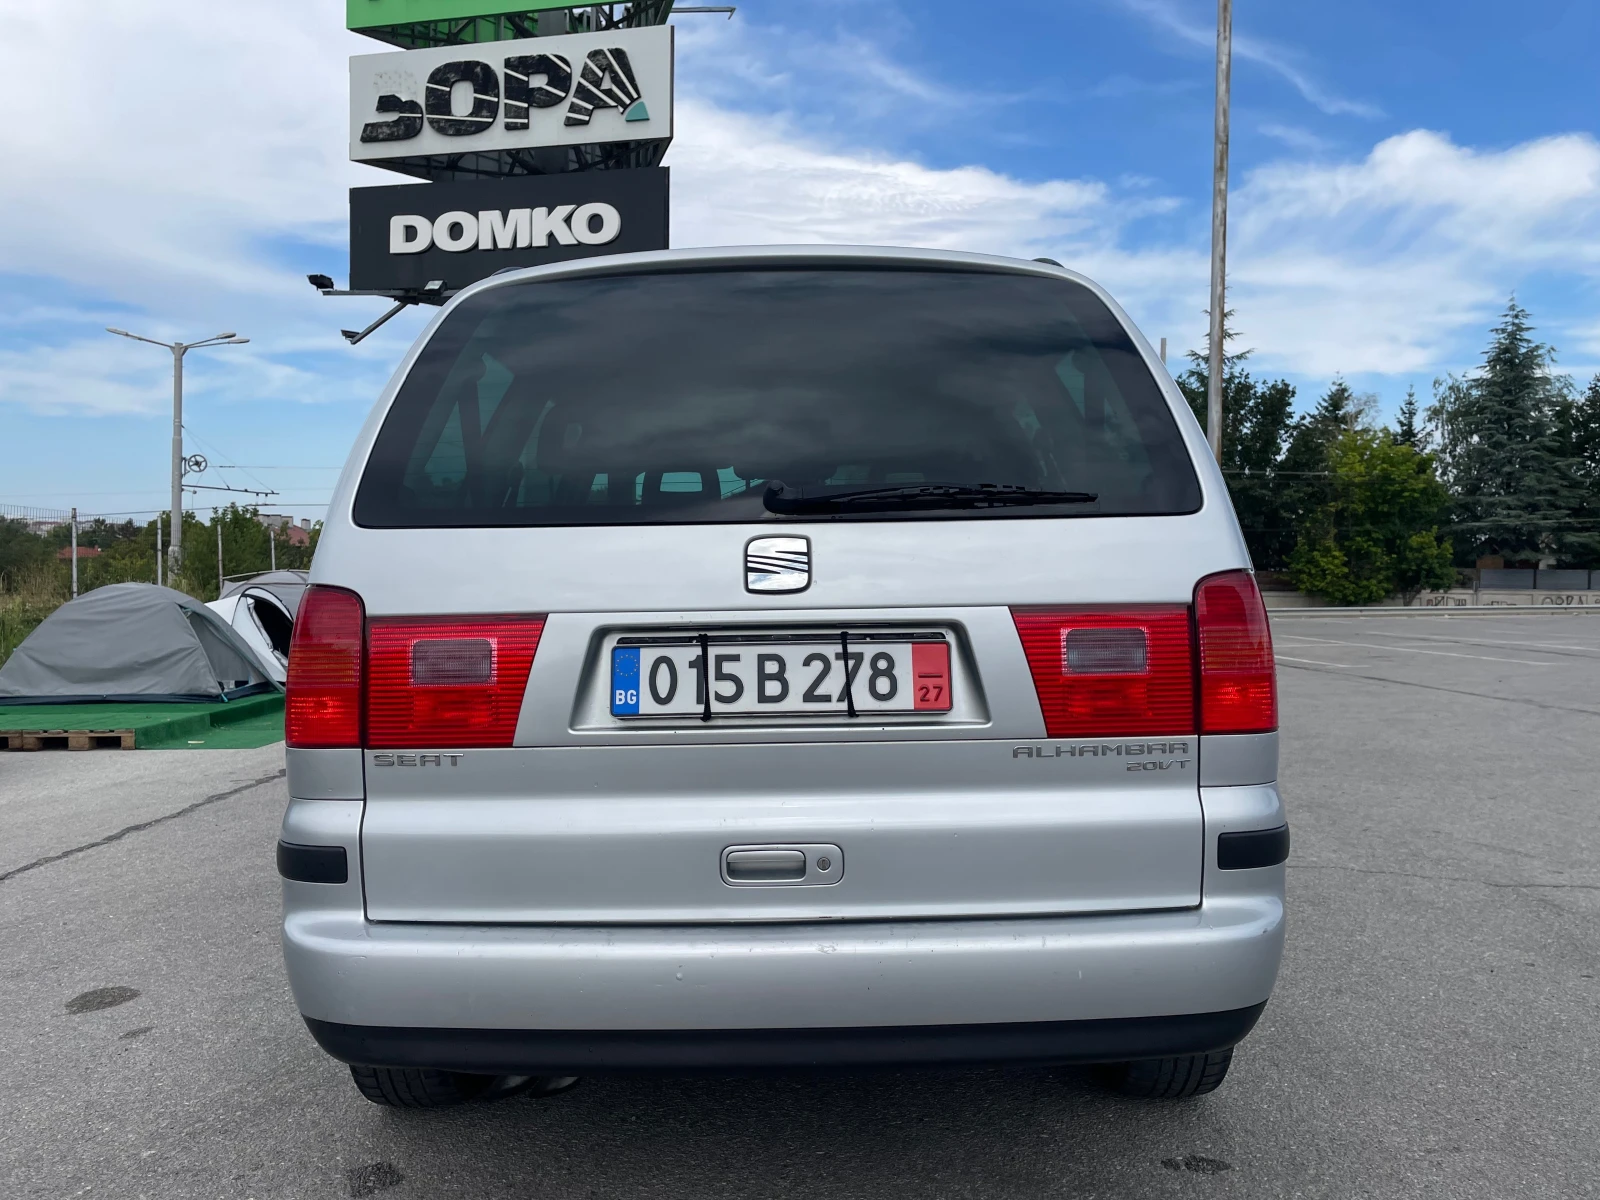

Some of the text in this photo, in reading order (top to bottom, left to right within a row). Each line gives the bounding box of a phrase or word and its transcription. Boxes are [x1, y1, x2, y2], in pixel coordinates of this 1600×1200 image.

[389, 202, 621, 254] DOMKO
[615, 690, 637, 705] BG
[918, 685, 943, 702] 27
[1012, 741, 1189, 758] ALHAMBRA
[373, 753, 464, 766] SEAT
